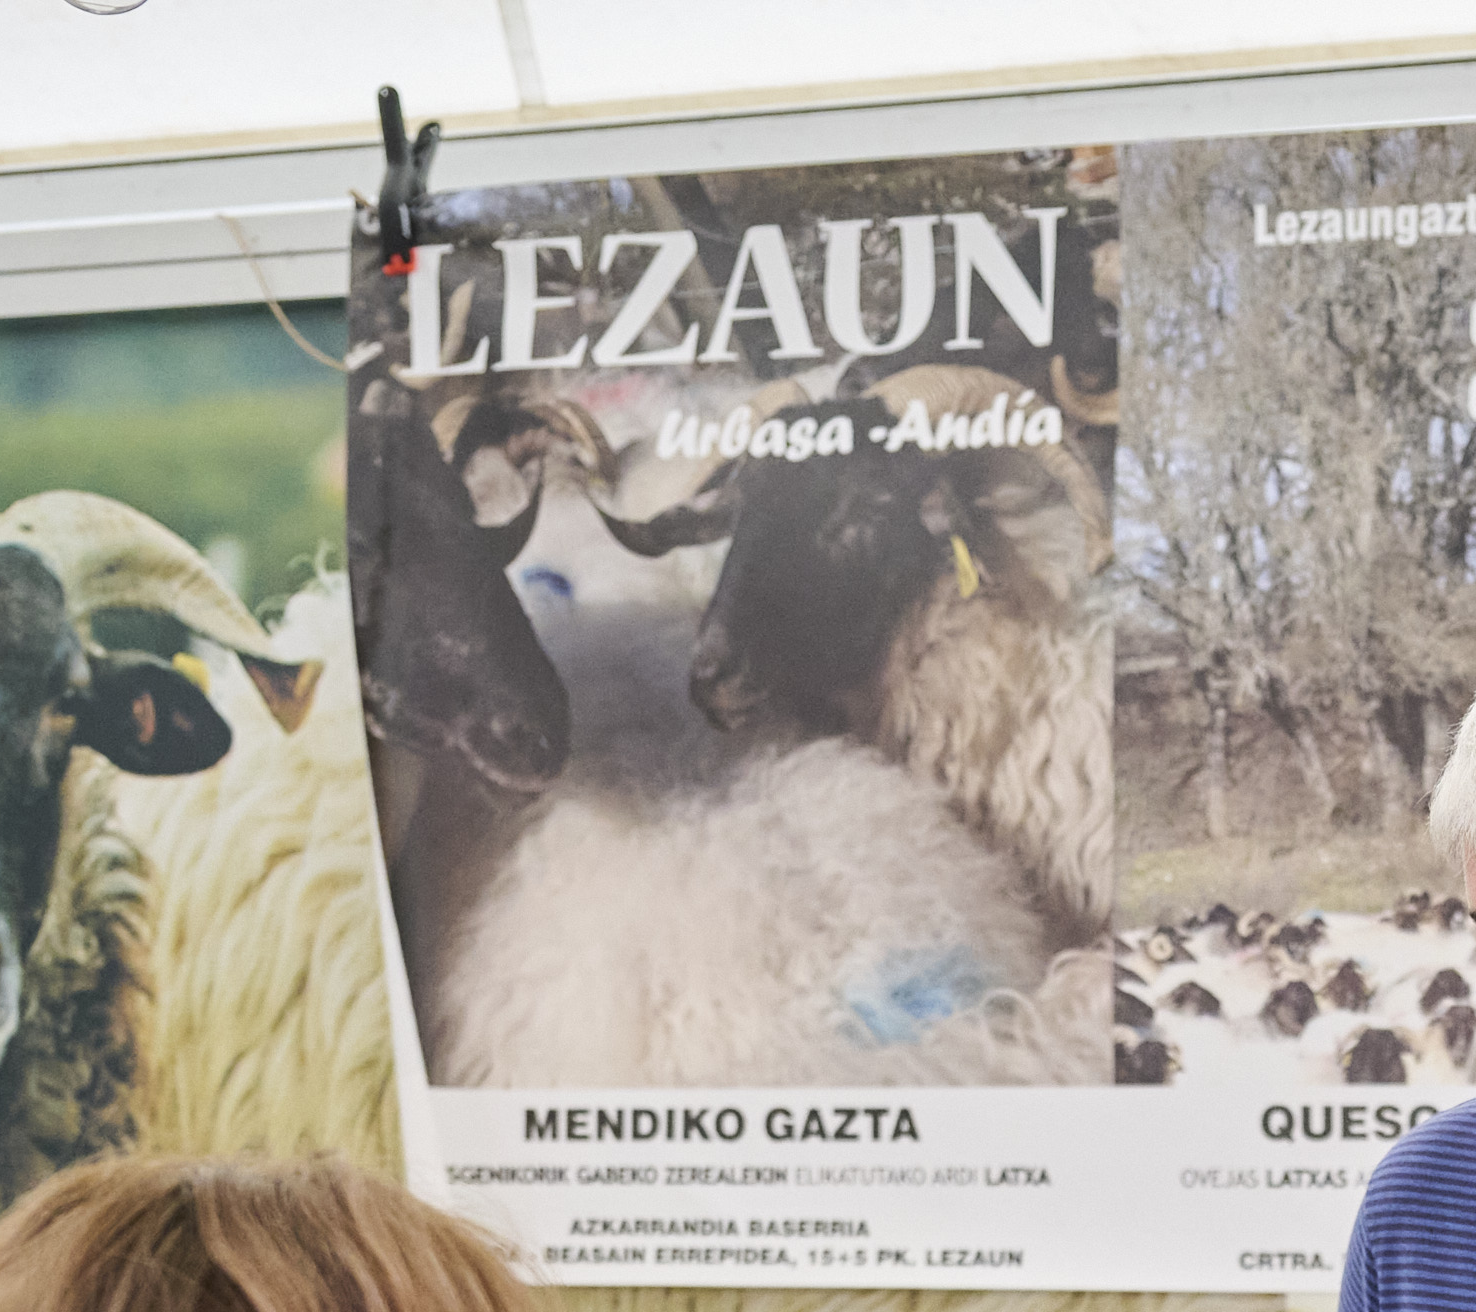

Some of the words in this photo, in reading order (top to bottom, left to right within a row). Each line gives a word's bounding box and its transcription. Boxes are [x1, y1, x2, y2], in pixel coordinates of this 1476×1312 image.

[392, 206, 1069, 377] LEZAUN
[657, 408, 854, 464] Urbasa
[524, 1108, 746, 1141] MENDIKO
[765, 1108, 921, 1142] GAZTA
[985, 1167, 1051, 1187] LATXA
[1180, 1169, 1259, 1189] OVEJAS
[1266, 1169, 1348, 1188] LATXAS
[748, 1219, 869, 1237] BASERRIA
[926, 1249, 1024, 1268] LEZAUN
